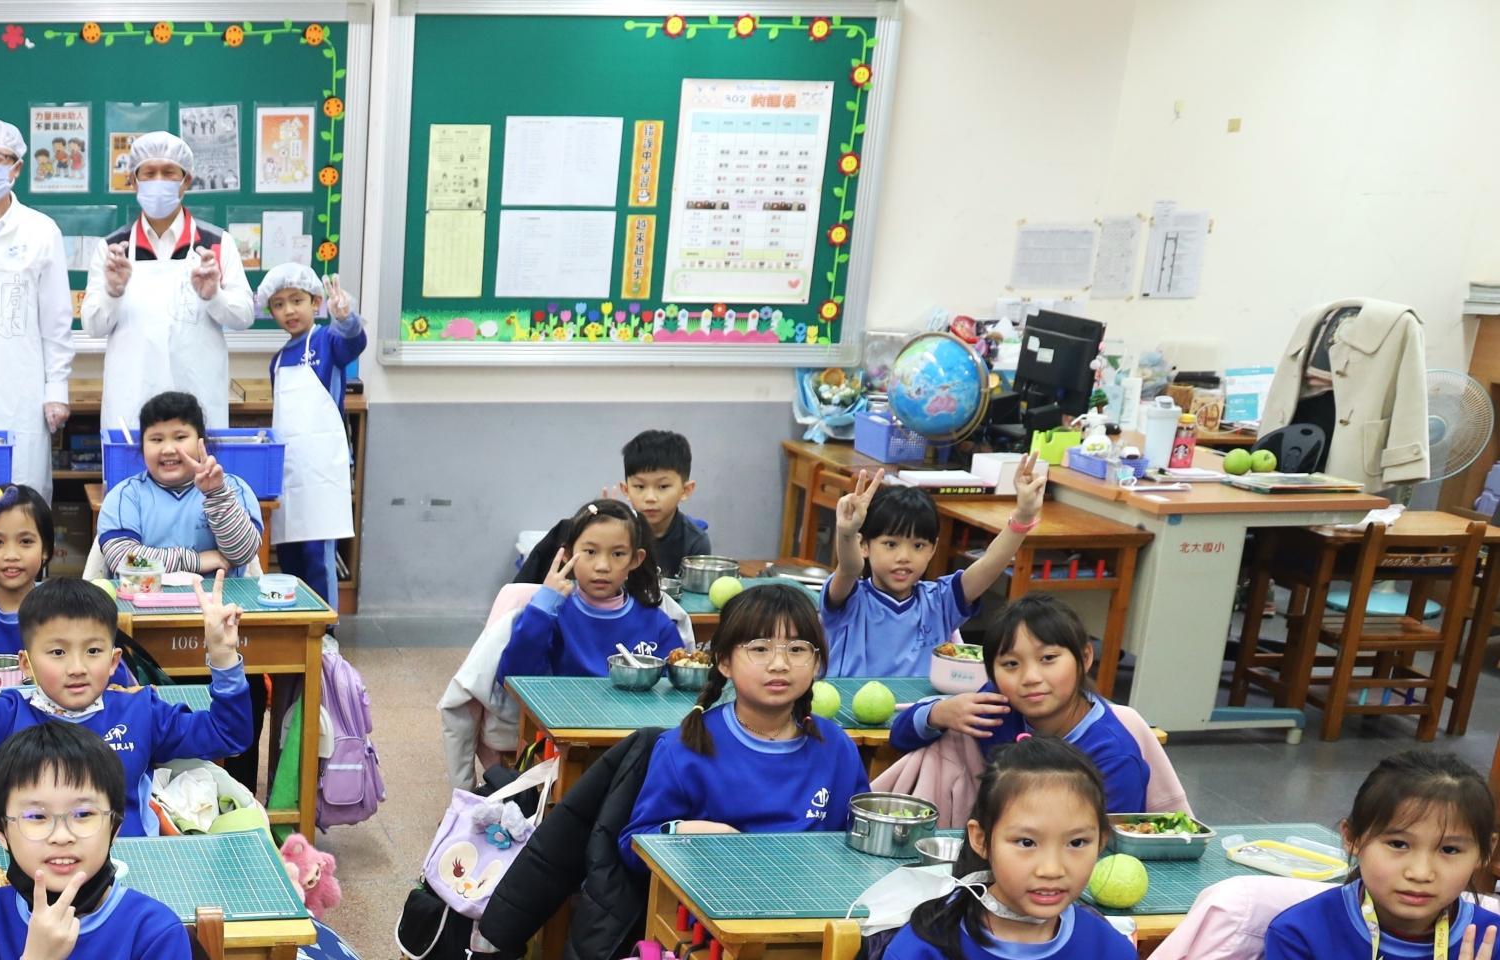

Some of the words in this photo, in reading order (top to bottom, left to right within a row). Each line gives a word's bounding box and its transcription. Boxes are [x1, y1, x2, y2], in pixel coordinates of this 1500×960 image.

[35, 111, 84, 120] 力量用來助人
[35, 122, 84, 130] 不要霸凌別人
[633, 219, 647, 280] 越來越進步
[1179, 542, 1225, 554] 北大國小
